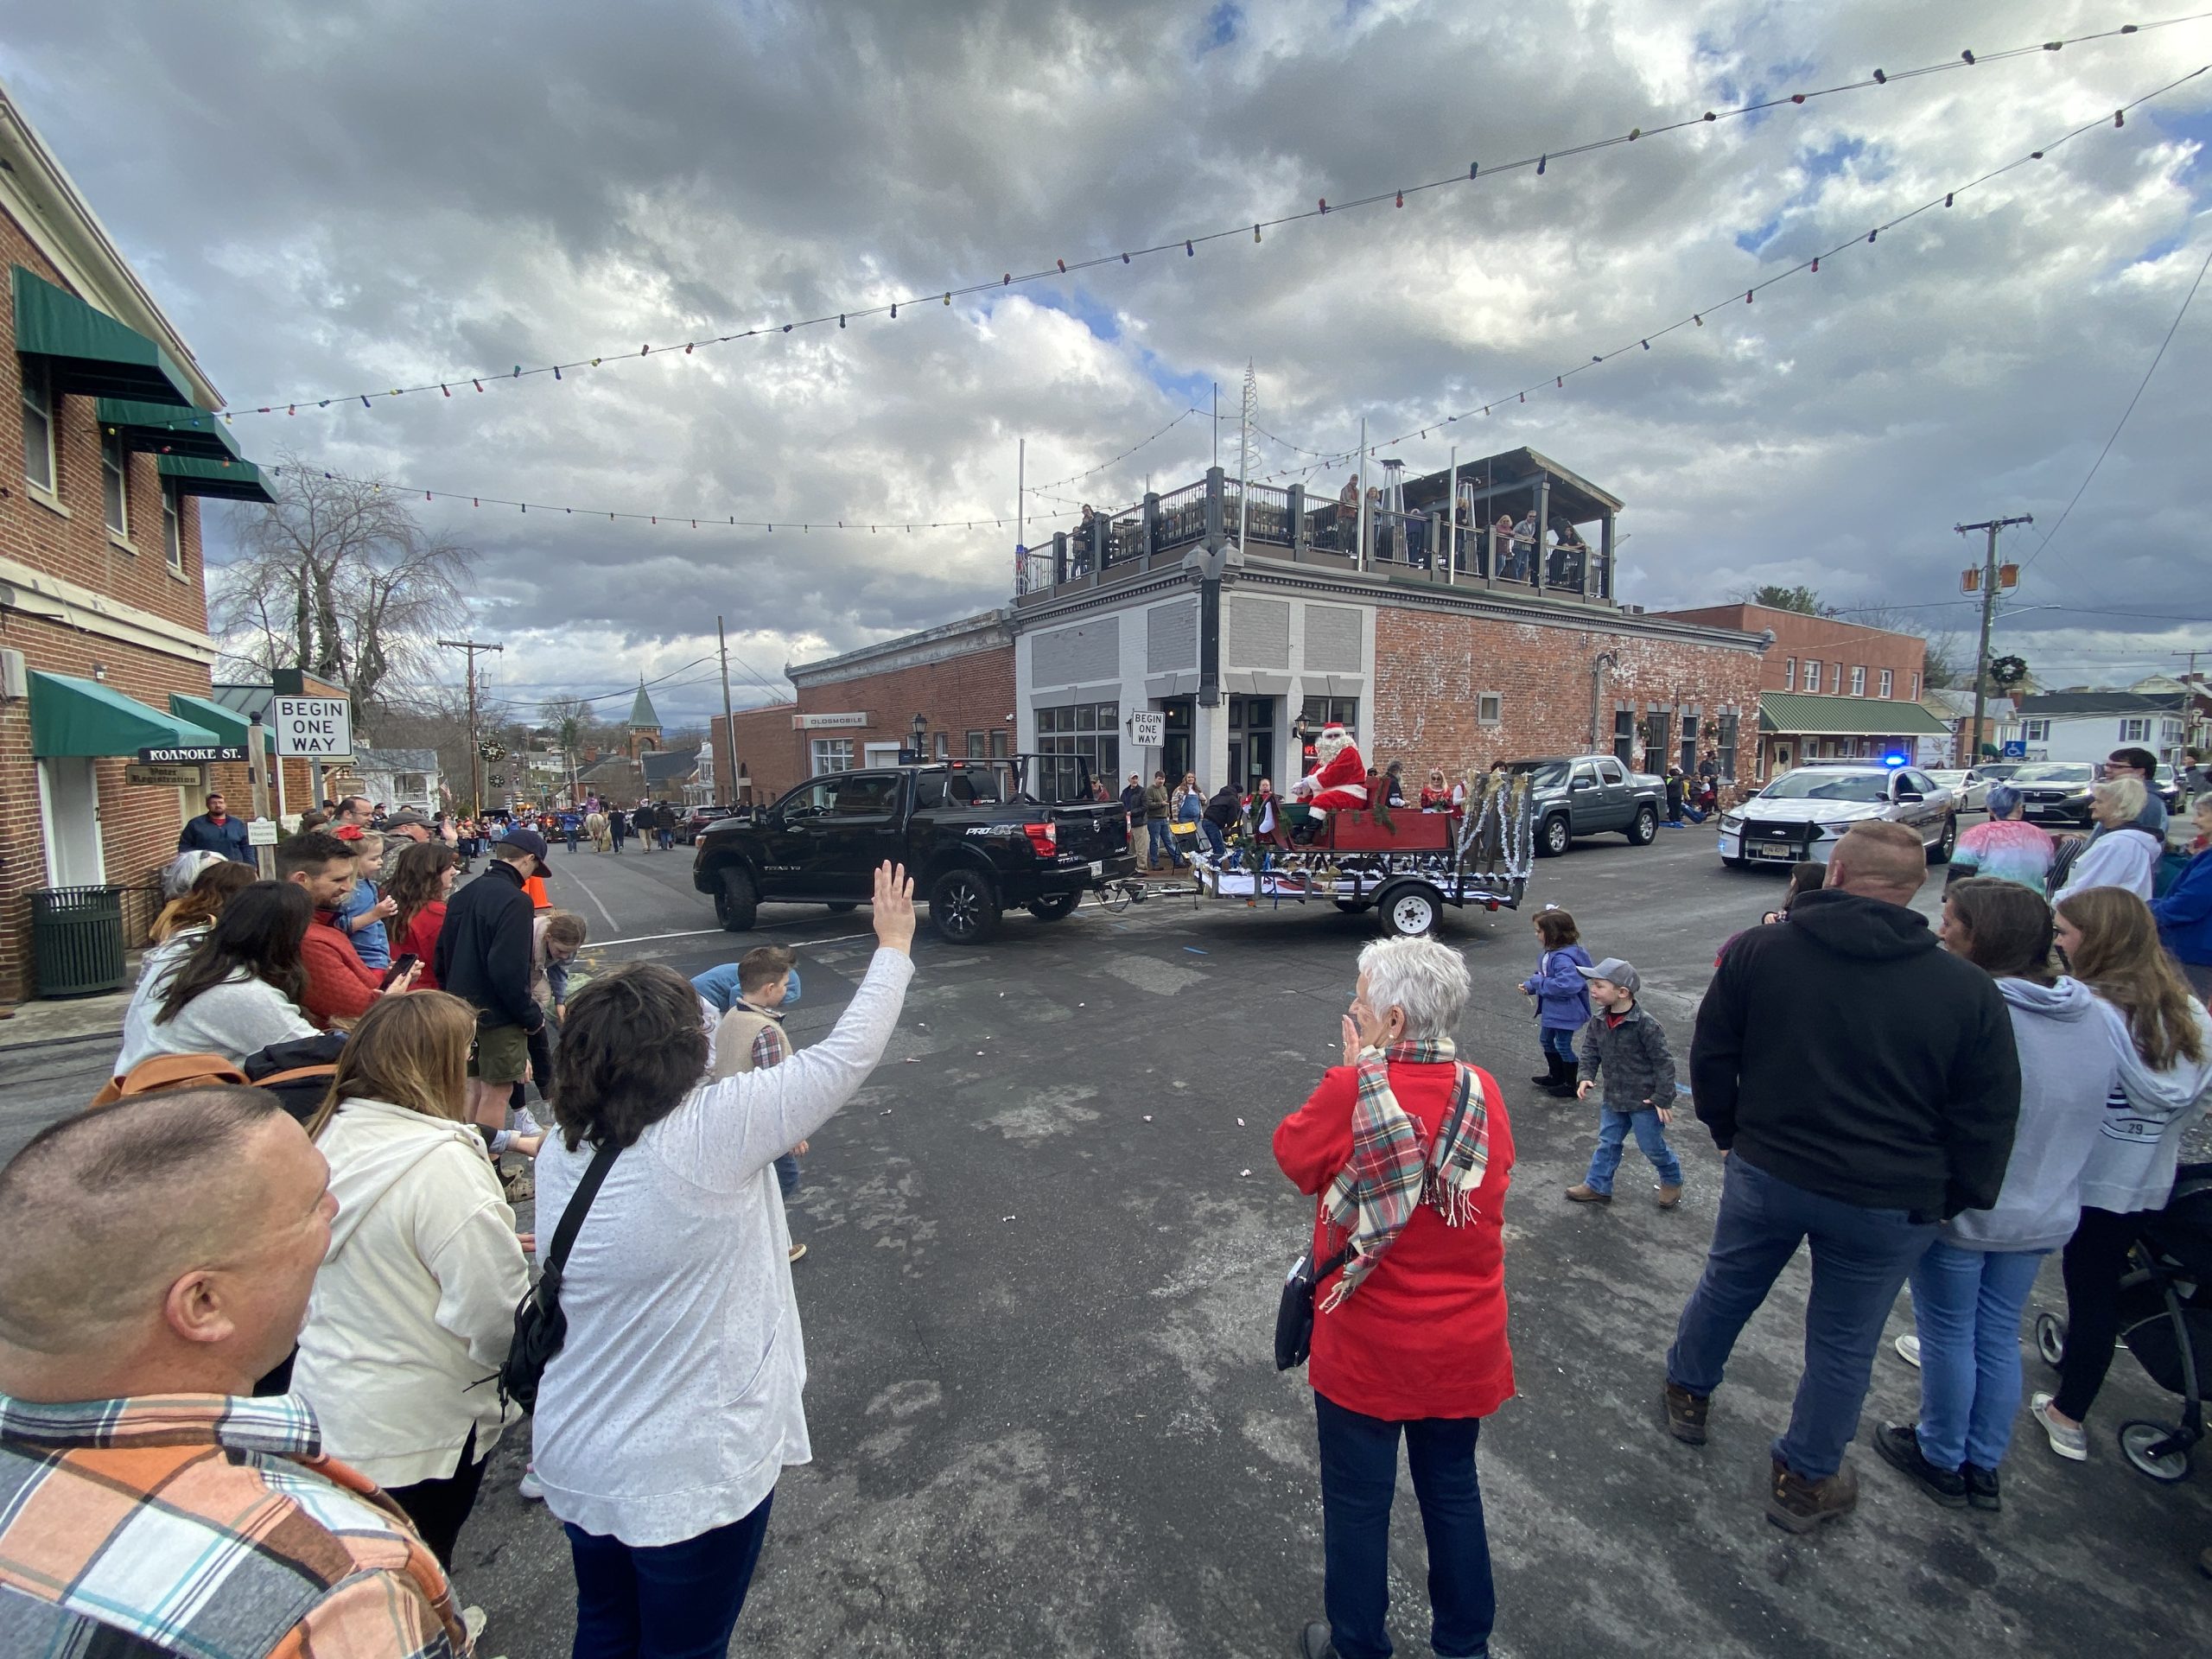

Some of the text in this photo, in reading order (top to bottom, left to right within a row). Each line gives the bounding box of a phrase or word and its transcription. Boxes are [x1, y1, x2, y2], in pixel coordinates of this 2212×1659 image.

[282, 702, 342, 716] BEGIN
[1135, 714, 1161, 723] BEGIN
[293, 720, 334, 734] ONE
[1139, 724, 1157, 734] ONE
[292, 738, 335, 752] WAY
[1138, 734, 1157, 744] WAY
[149, 748, 242, 760] ROANOKE ST.
[2128, 1123, 2143, 1135] 29
